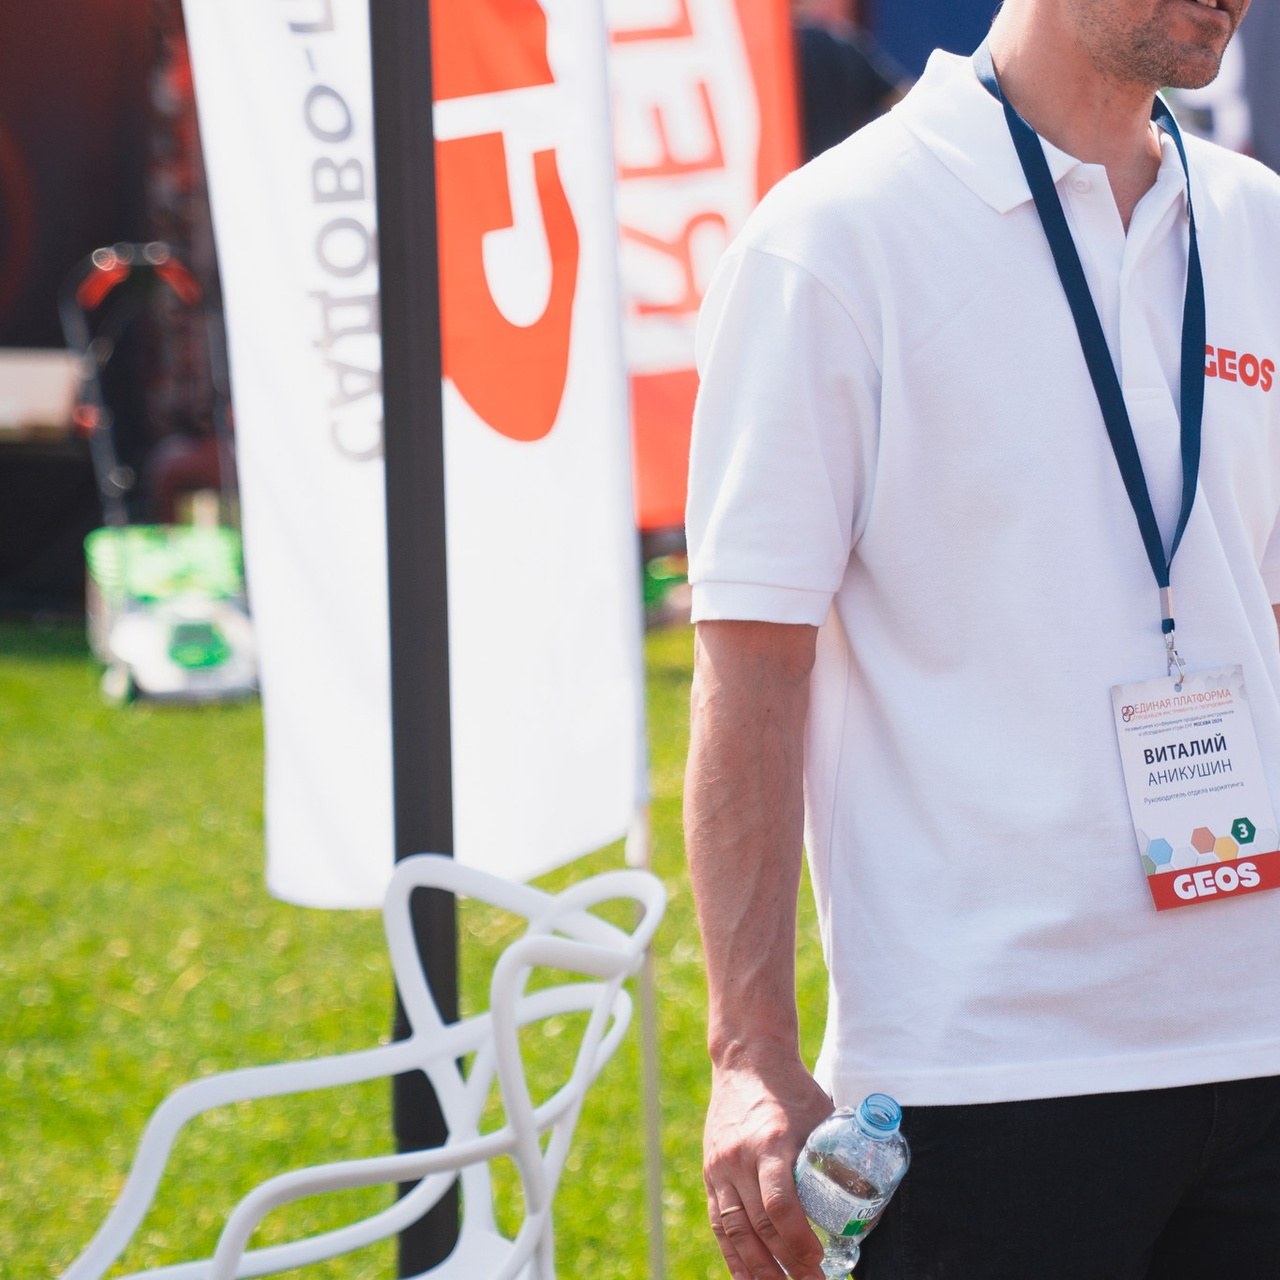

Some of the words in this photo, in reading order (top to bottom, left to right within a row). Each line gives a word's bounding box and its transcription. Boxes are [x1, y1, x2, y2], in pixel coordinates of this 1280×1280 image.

[1205, 344, 1275, 392] GEOS
[1134, 698, 1171, 714] ЕДИНАЯ
[1174, 689, 1231, 706] ПЛАТФОРМА
[1144, 733, 1226, 765] ВИТАЛИЙ
[1148, 758, 1232, 786] АНИКУШИН
[1187, 789, 1208, 797] отдела
[1209, 782, 1244, 793] маркетинга
[1238, 823, 1249, 838] 3
[1173, 862, 1260, 900] GEOS
